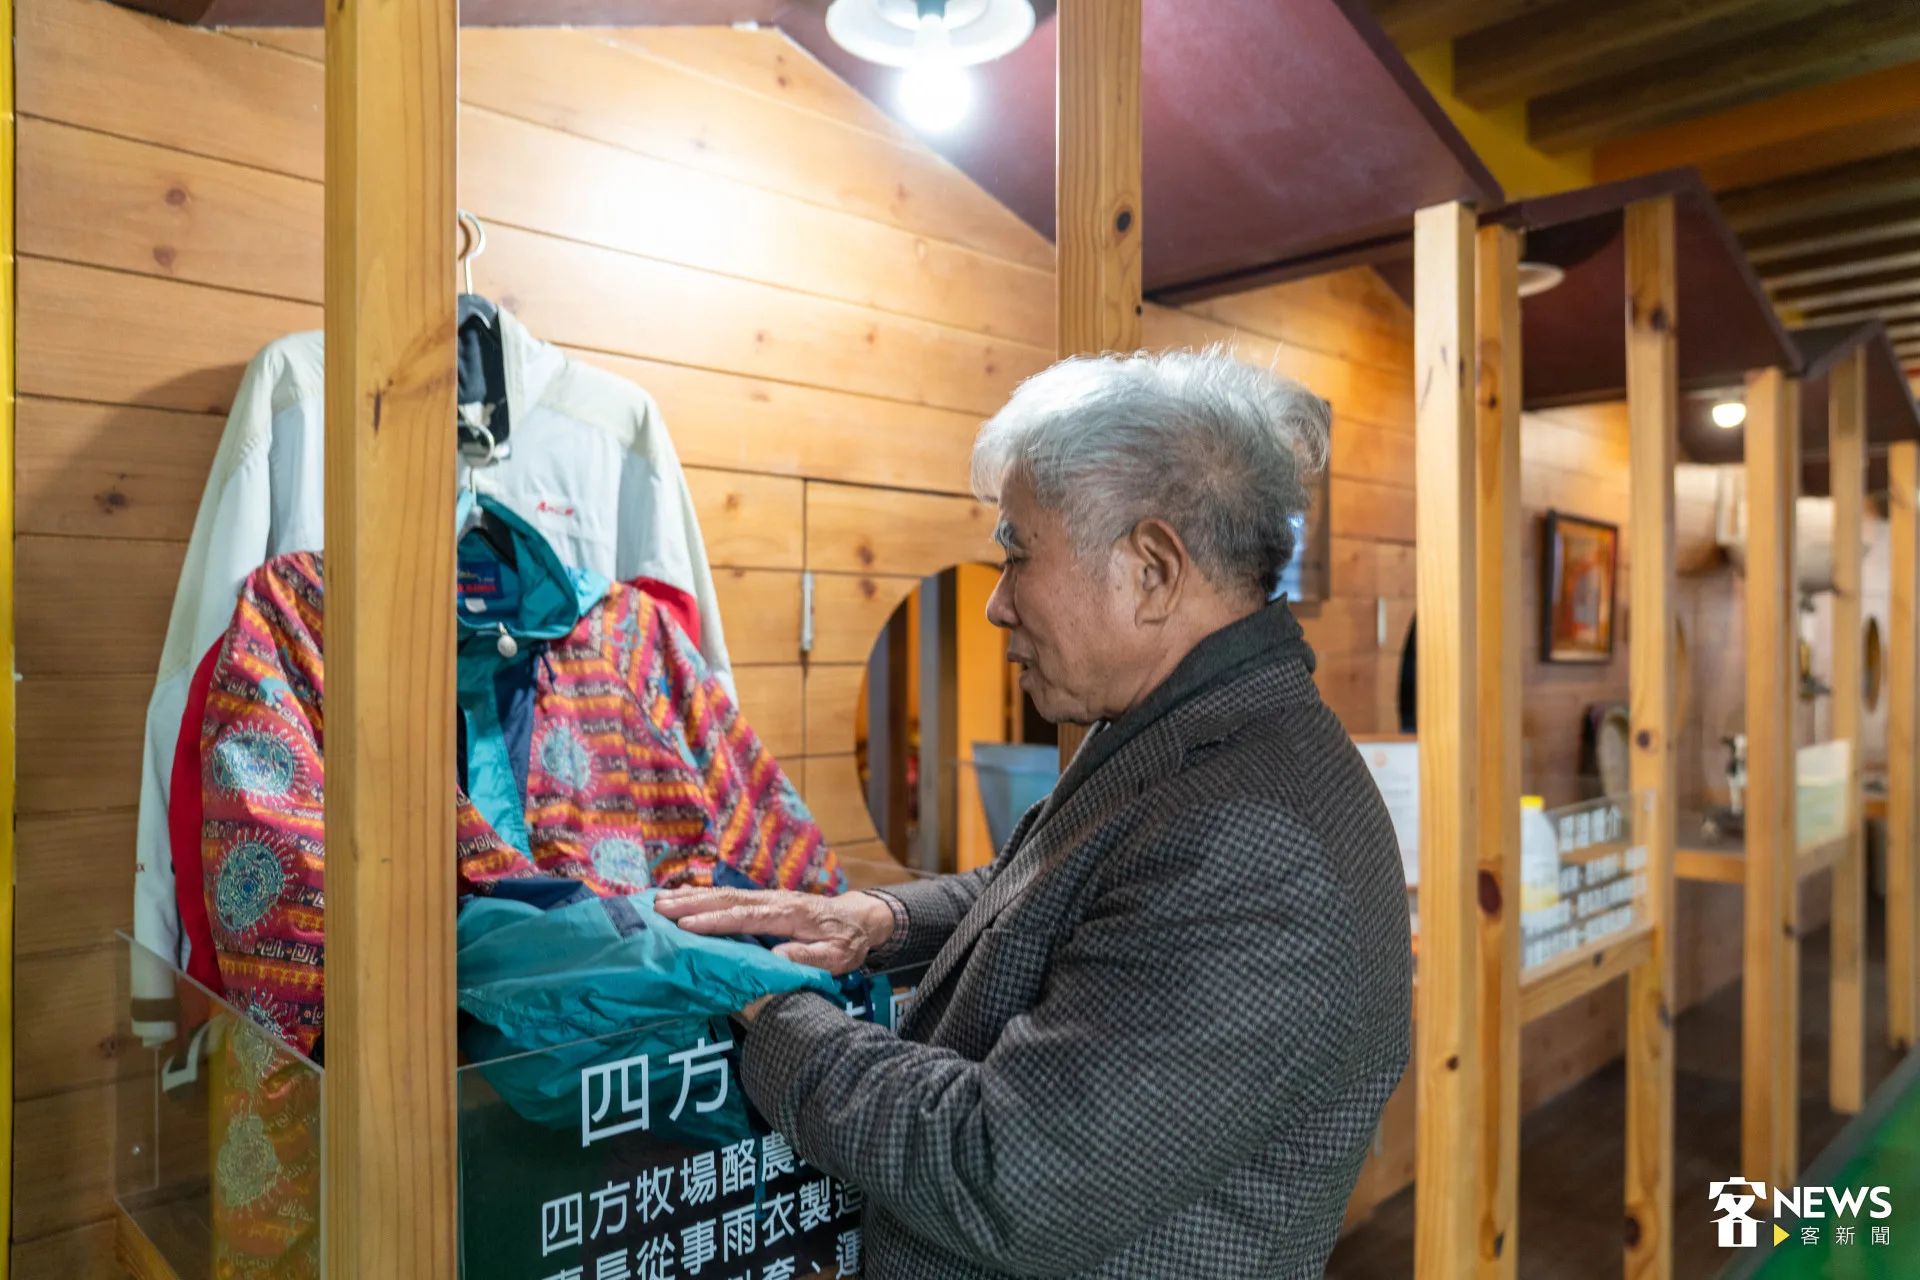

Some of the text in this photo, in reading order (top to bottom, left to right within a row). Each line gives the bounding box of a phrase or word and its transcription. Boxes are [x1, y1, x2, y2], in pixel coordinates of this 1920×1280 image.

[581, 1037, 734, 1147] 四方
[541, 1130, 806, 1257] 四方牧場酪農
